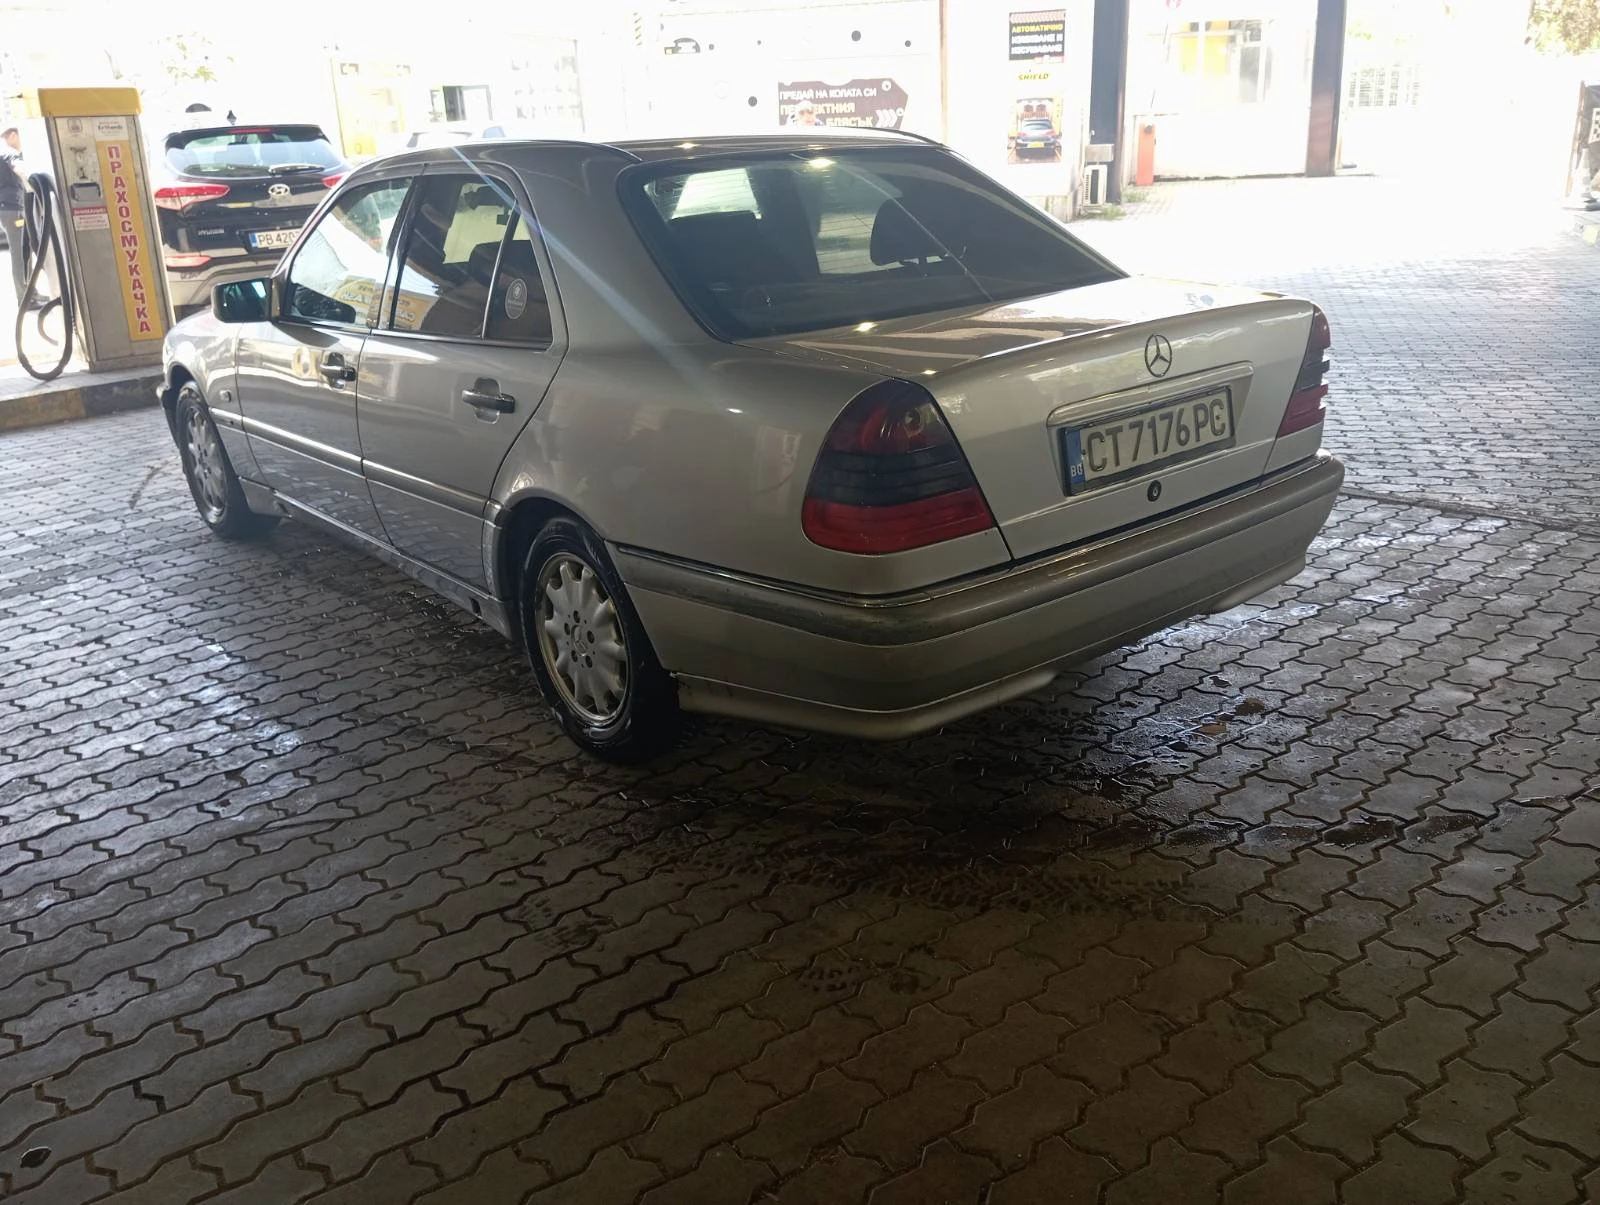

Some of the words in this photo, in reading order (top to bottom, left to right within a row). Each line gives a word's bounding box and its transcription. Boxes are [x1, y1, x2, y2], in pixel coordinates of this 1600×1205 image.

[780, 89, 814, 100] ПРЕДАЙ
[815, 88, 828, 99] НА
[829, 88, 862, 99] КОЛАТА
[863, 87, 877, 97] СИ
[780, 103, 855, 115] ПЕЕКТНИЯ
[107, 146, 150, 332] ПРАХОСМУКАЧКА
